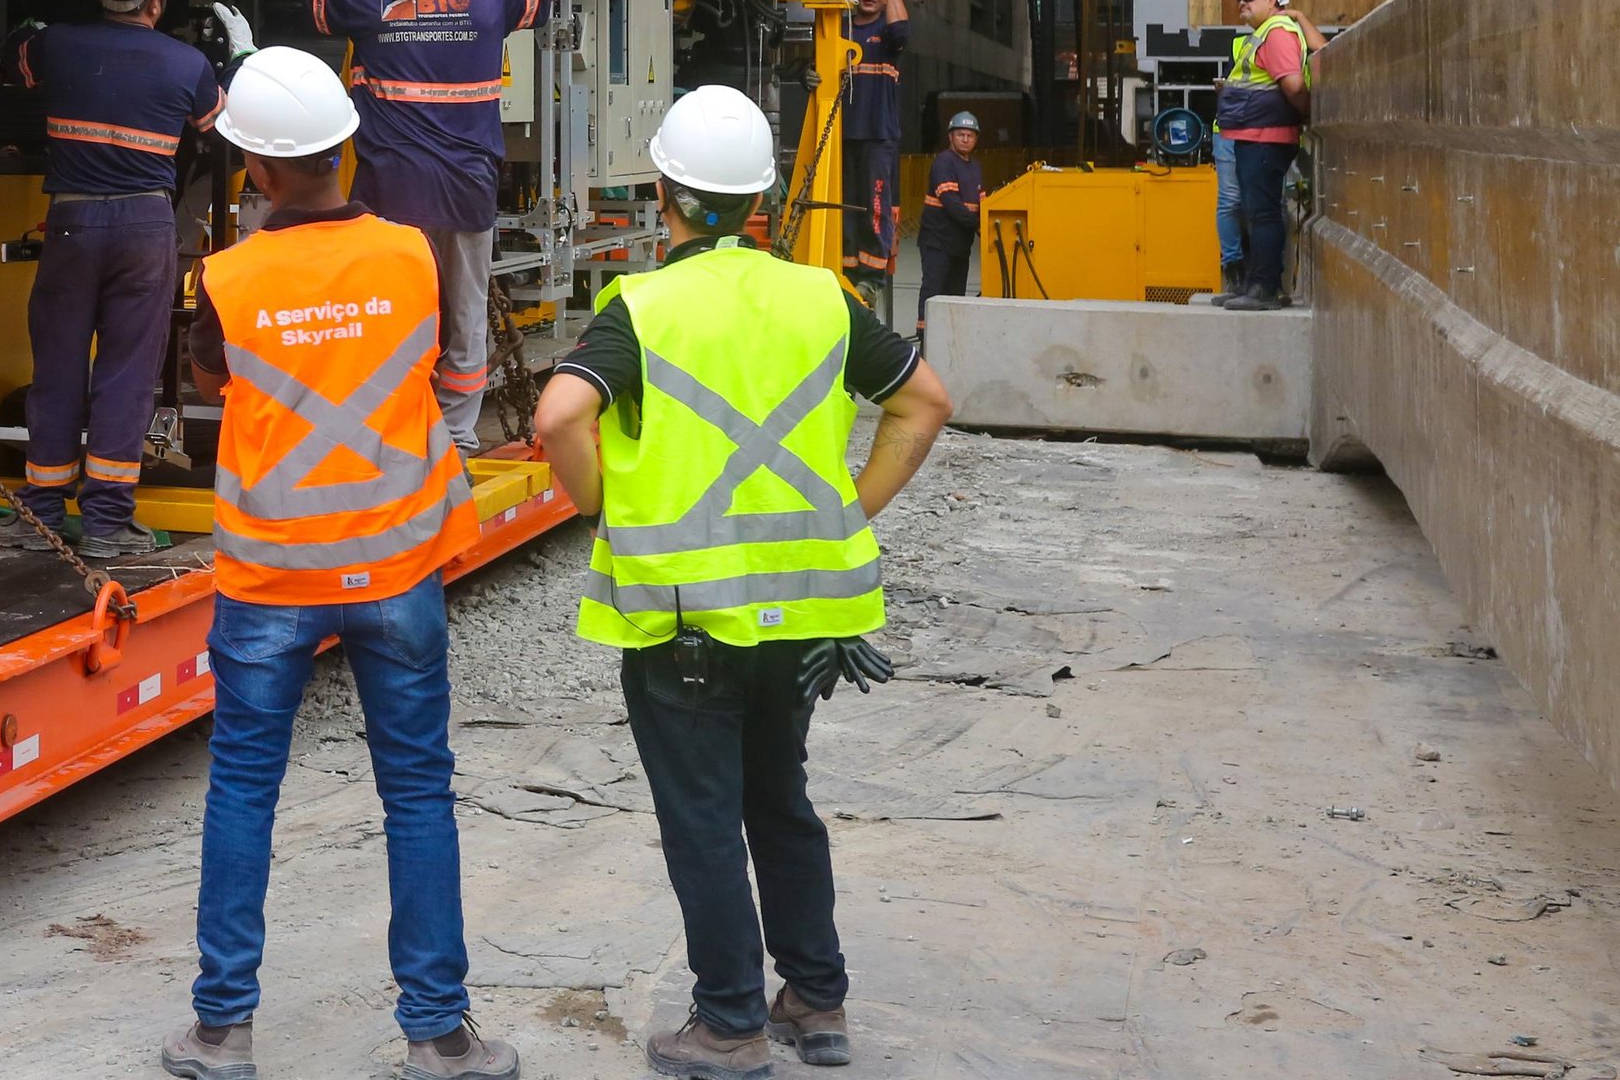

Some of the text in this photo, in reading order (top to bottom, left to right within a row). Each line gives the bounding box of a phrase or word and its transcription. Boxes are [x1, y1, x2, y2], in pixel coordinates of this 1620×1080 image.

[256, 297, 392, 329] A serviço da
[281, 322, 363, 346] Skyrail
